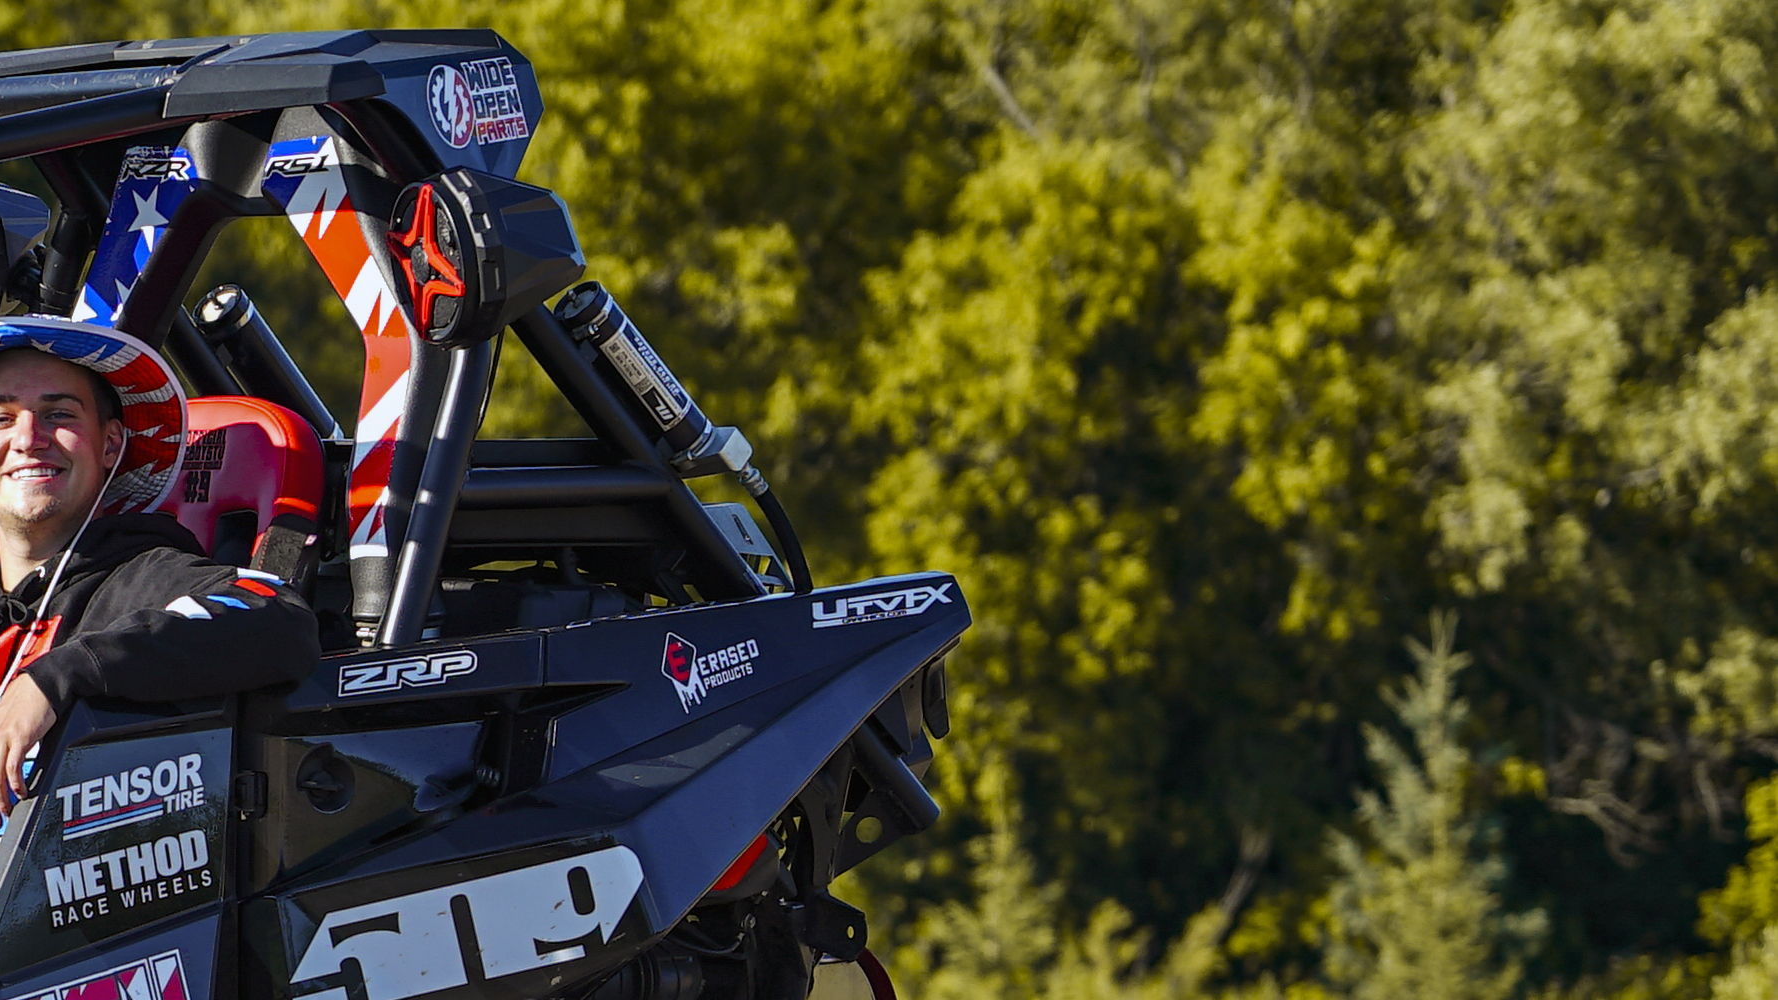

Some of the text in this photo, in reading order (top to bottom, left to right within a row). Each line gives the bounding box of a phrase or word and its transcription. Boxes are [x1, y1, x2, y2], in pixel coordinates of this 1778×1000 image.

[461, 57, 513, 92] WIDE
[472, 88, 523, 119] OPEN
[475, 116, 530, 145] PARTS
[341, 652, 477, 695] ZRP
[697, 638, 760, 676] ERASED
[703, 662, 754, 690] PRODUCTS
[55, 753, 204, 822] TENSOR
[163, 787, 207, 813] TIRE
[44, 830, 209, 907] METHOD
[51, 869, 212, 928] RACE WHEELS
